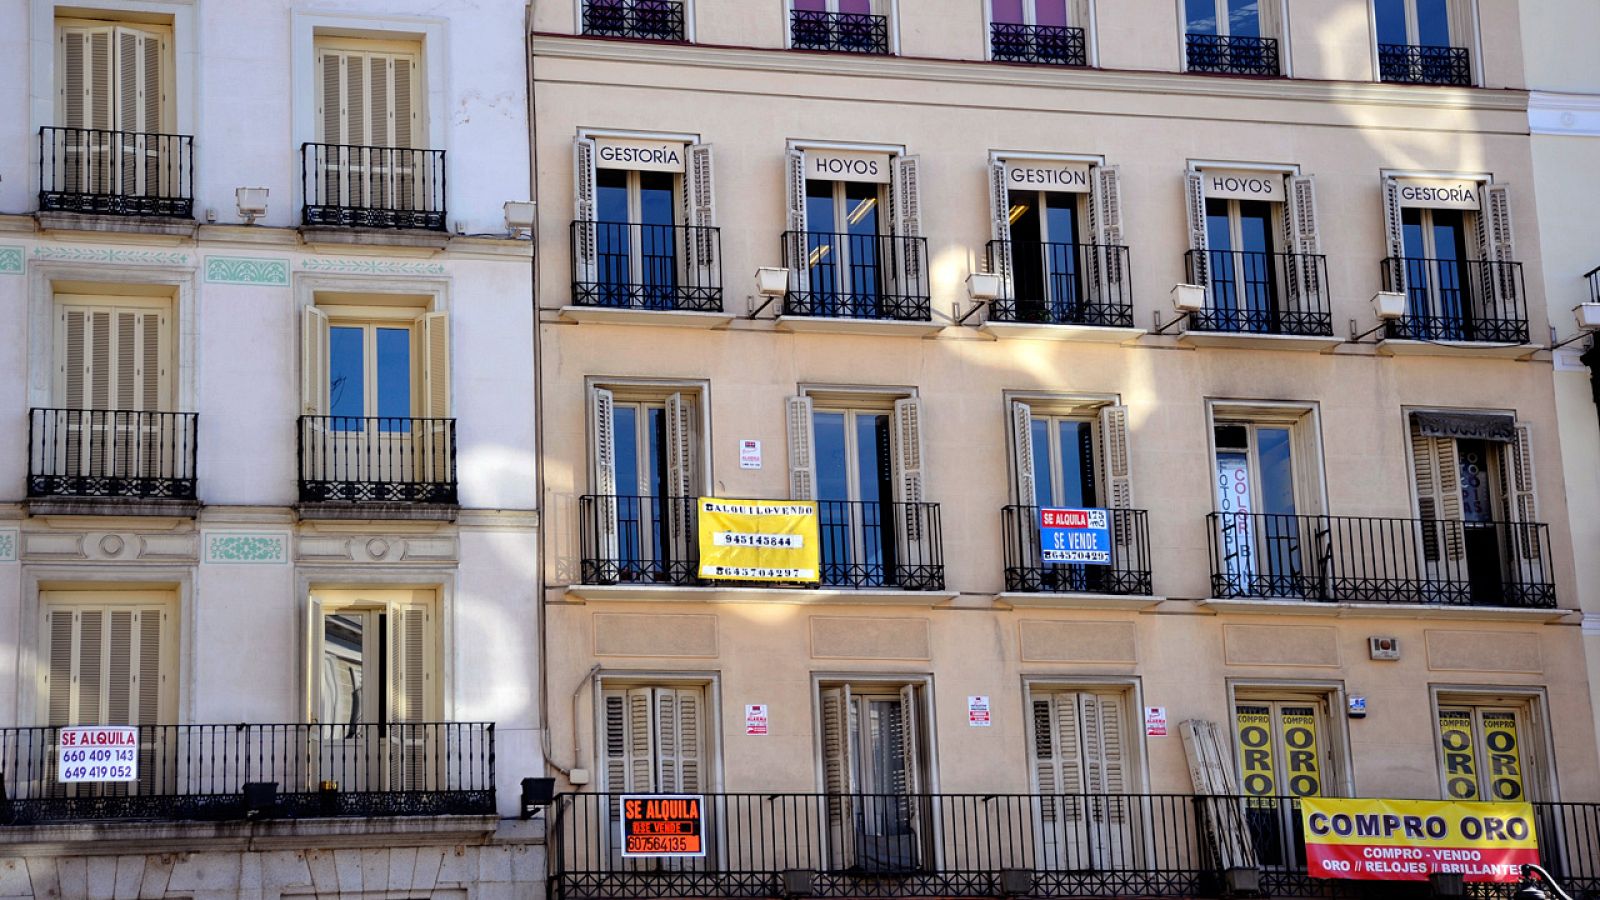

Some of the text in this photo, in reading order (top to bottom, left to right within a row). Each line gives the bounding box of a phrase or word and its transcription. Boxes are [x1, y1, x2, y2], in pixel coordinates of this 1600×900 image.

[600, 145, 680, 164] GESTORÍA
[816, 158, 878, 175] HOYOS
[1010, 166, 1086, 185] GESTIÓN
[1213, 176, 1272, 193] HOYOS
[1401, 184, 1475, 202] GESTORÍA
[1044, 513, 1086, 526] SE ALQUILA
[1053, 532, 1098, 550] SE VENDE
[62, 732, 136, 745] SE ALQUILA
[63, 749, 134, 762] 660 409 143
[1240, 726, 1273, 796] ORO
[1285, 727, 1319, 797] ORO
[64, 766, 132, 778] 649 419 052
[1442, 730, 1476, 799] ORO
[1486, 731, 1522, 800] ORO
[625, 799, 699, 820] SE ALQUILA
[653, 822, 681, 833] VENDE
[1309, 812, 1529, 841] COMPRO ORO
[628, 837, 687, 852] 607564135
[1363, 847, 1423, 860] COMPRO
[1433, 849, 1481, 861] VENDO
[1322, 859, 1351, 872] ORO
[1365, 861, 1427, 874] RELOJES
